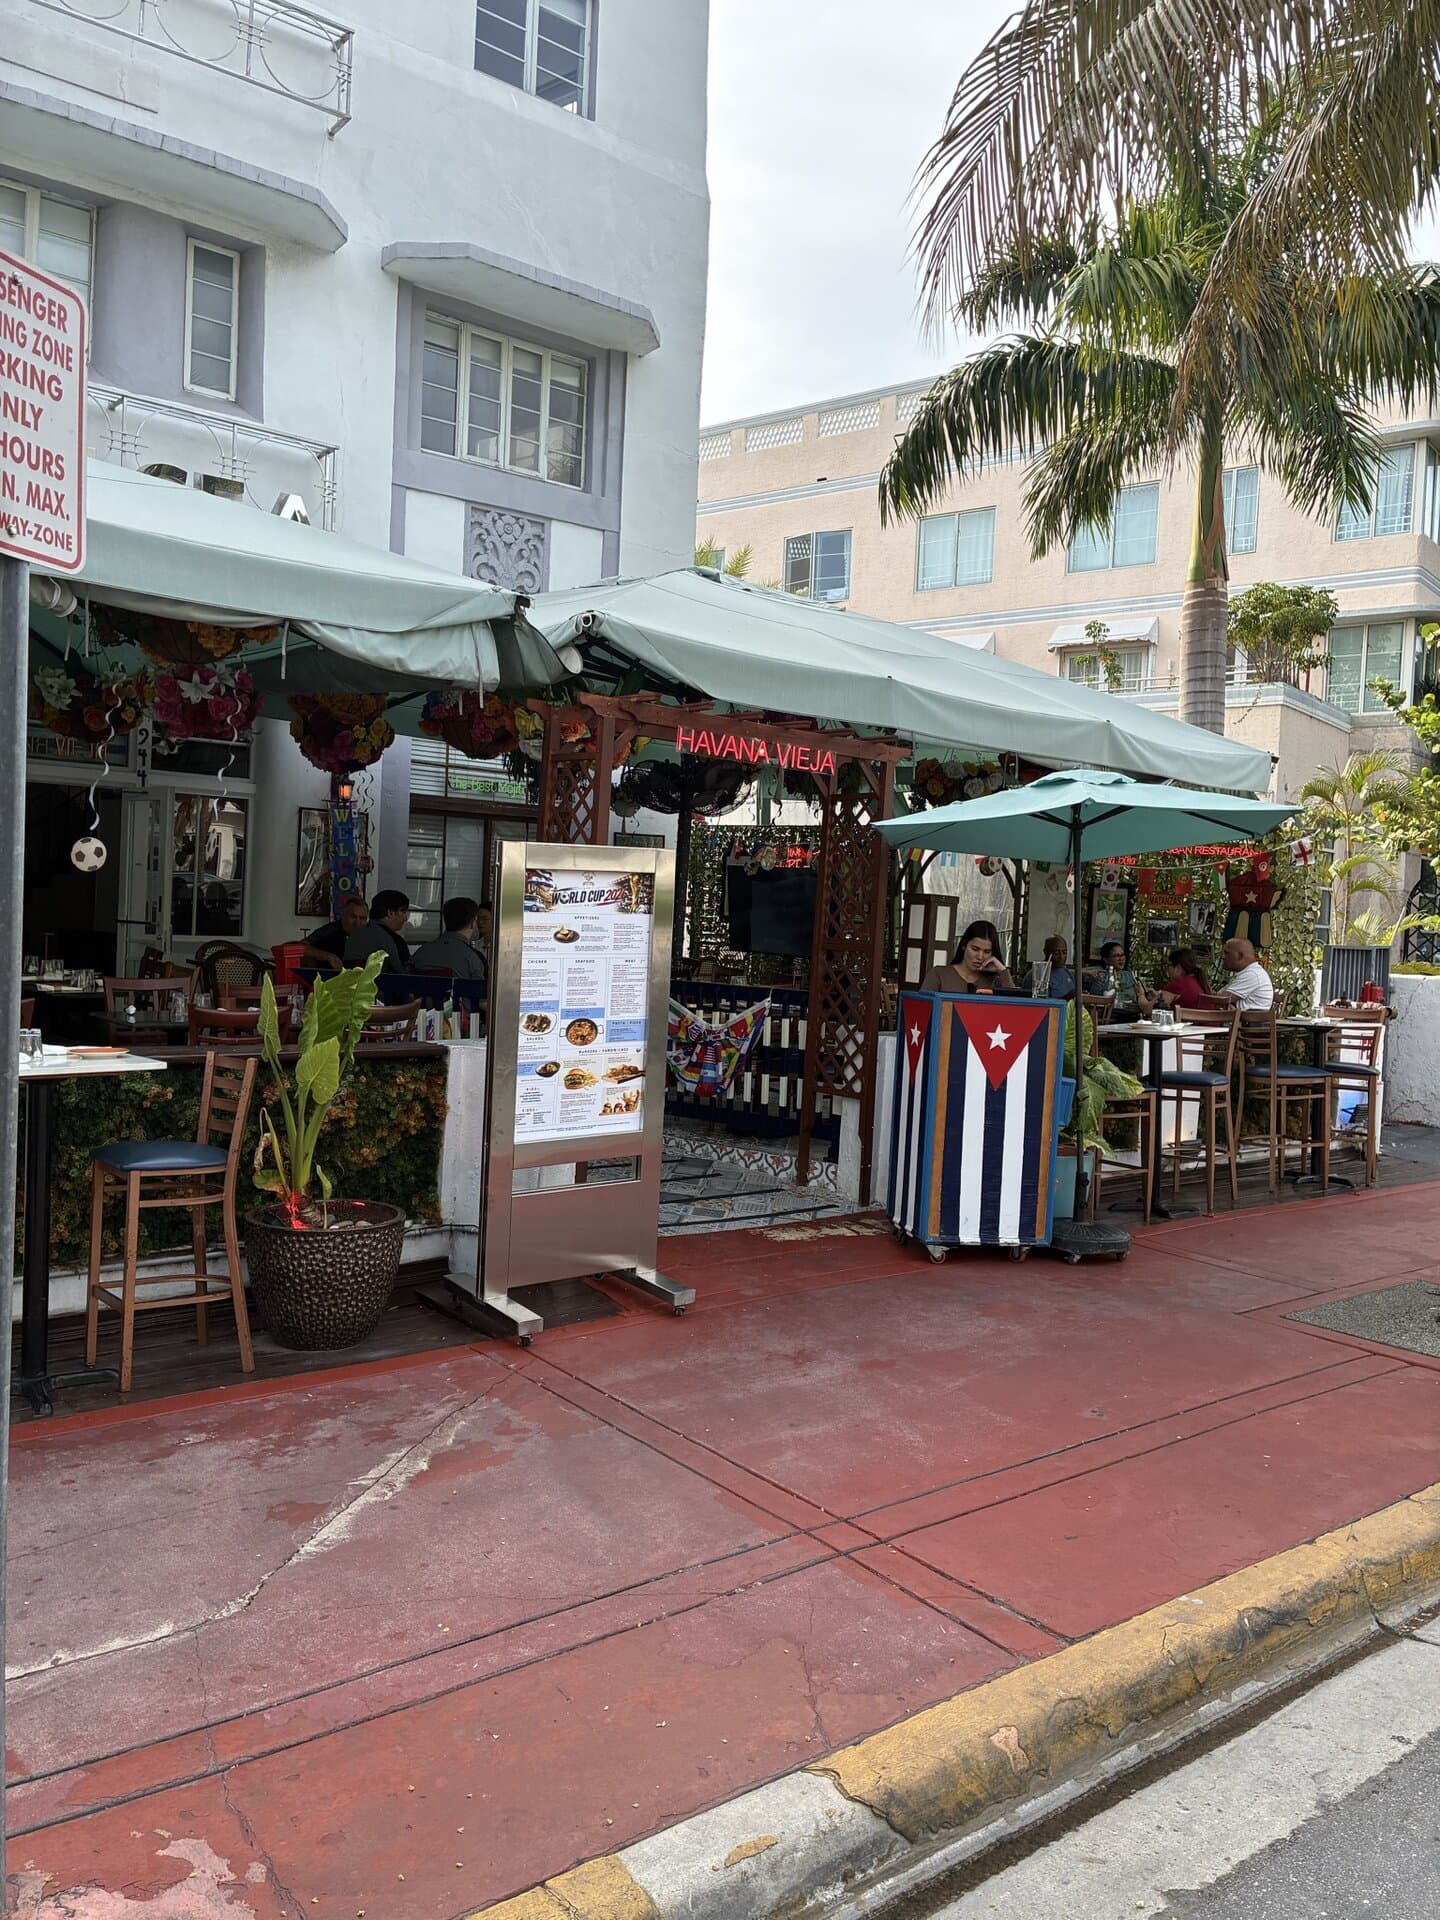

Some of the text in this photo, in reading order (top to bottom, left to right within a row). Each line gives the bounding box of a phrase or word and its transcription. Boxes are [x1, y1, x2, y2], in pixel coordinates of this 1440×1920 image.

[32, 328, 73, 373] ZONE
[0, 391, 43, 432] NLY
[26, 481, 70, 521] MAX.
[137, 728, 150, 788] 944
[676, 724, 835, 776] HAVANA VIEJA
[552, 890, 588, 905] WORLD
[588, 889, 605, 903] CUP
